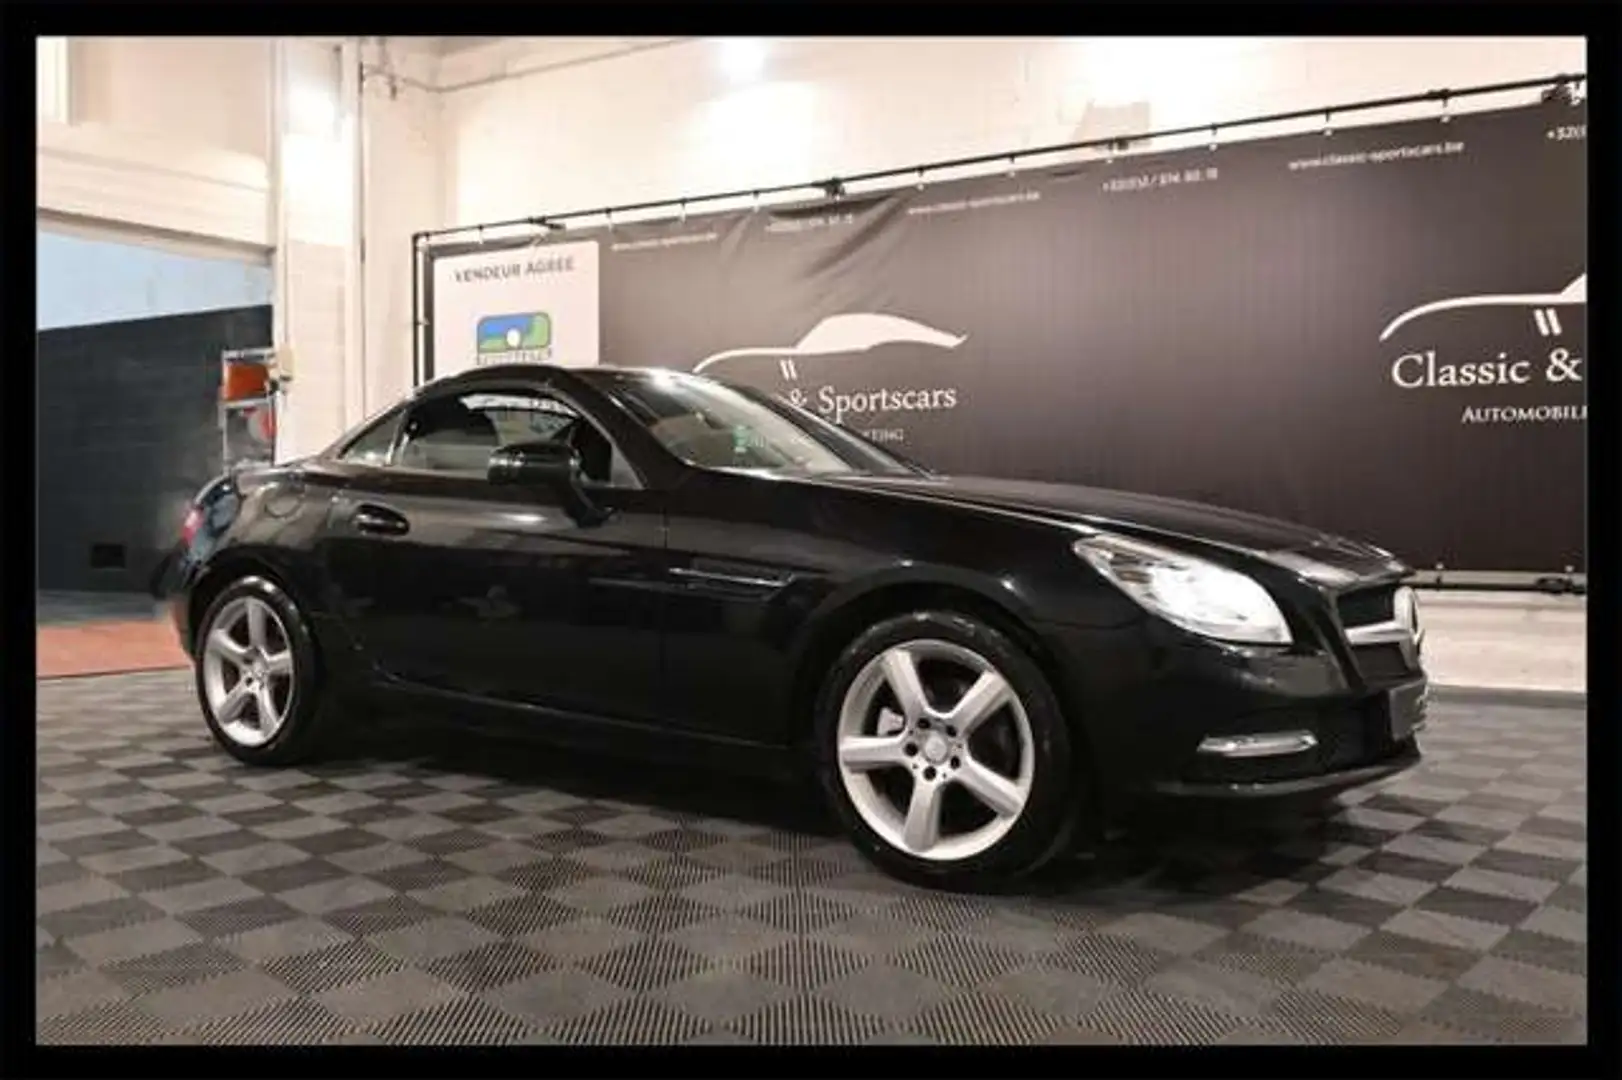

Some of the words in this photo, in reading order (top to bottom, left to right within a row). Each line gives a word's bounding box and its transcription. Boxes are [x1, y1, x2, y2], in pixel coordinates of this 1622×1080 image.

[1391, 350, 1531, 388] Classic
[1546, 347, 1583, 381] &
[818, 385, 957, 424] Sportscars
